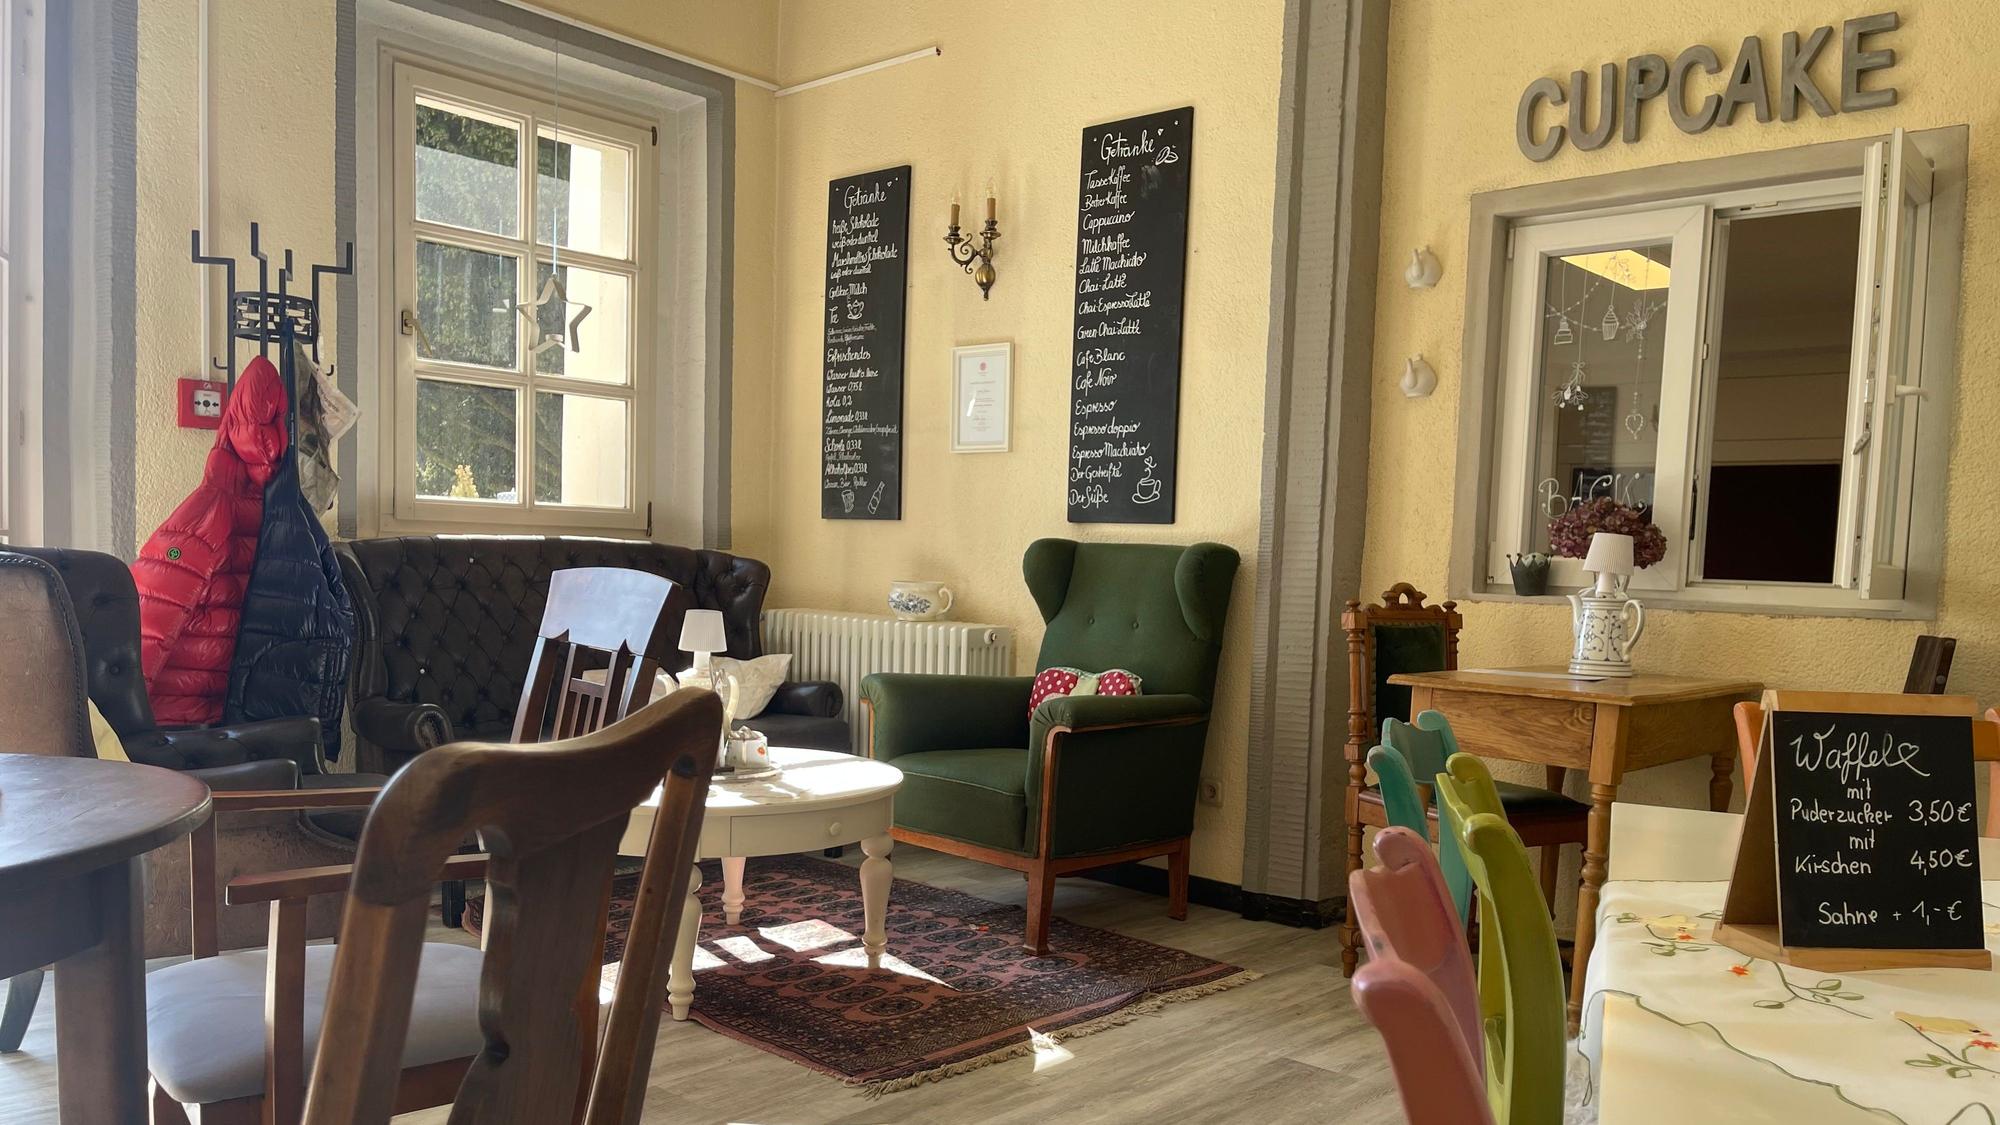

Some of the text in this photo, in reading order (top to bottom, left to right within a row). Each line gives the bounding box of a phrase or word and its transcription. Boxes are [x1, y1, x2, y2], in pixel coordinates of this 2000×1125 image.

[1515, 11, 1900, 163] CUPCAKE
[1101, 129, 1155, 165] Getränke
[1084, 165, 1131, 191] Tasse Kaffee
[844, 182, 887, 215] Getränke
[1079, 256, 1101, 274] Latte
[1093, 347, 1126, 365] Blanc
[1094, 367, 1118, 386] Noir
[1075, 399, 1118, 420] Espresso
[1074, 416, 1141, 441] Espresso doppio
[1072, 445, 1106, 468] Espresso
[1070, 467, 1085, 482] Der
[1069, 484, 1109, 509] Der Süße
[1790, 724, 1897, 784] Waffel
[1847, 777, 1872, 800] mit
[1790, 798, 1893, 825] Puderzucker
[1849, 828, 1876, 850] mit
[1795, 851, 1872, 875] Kirschen
[1818, 901, 1878, 925] Sahne
